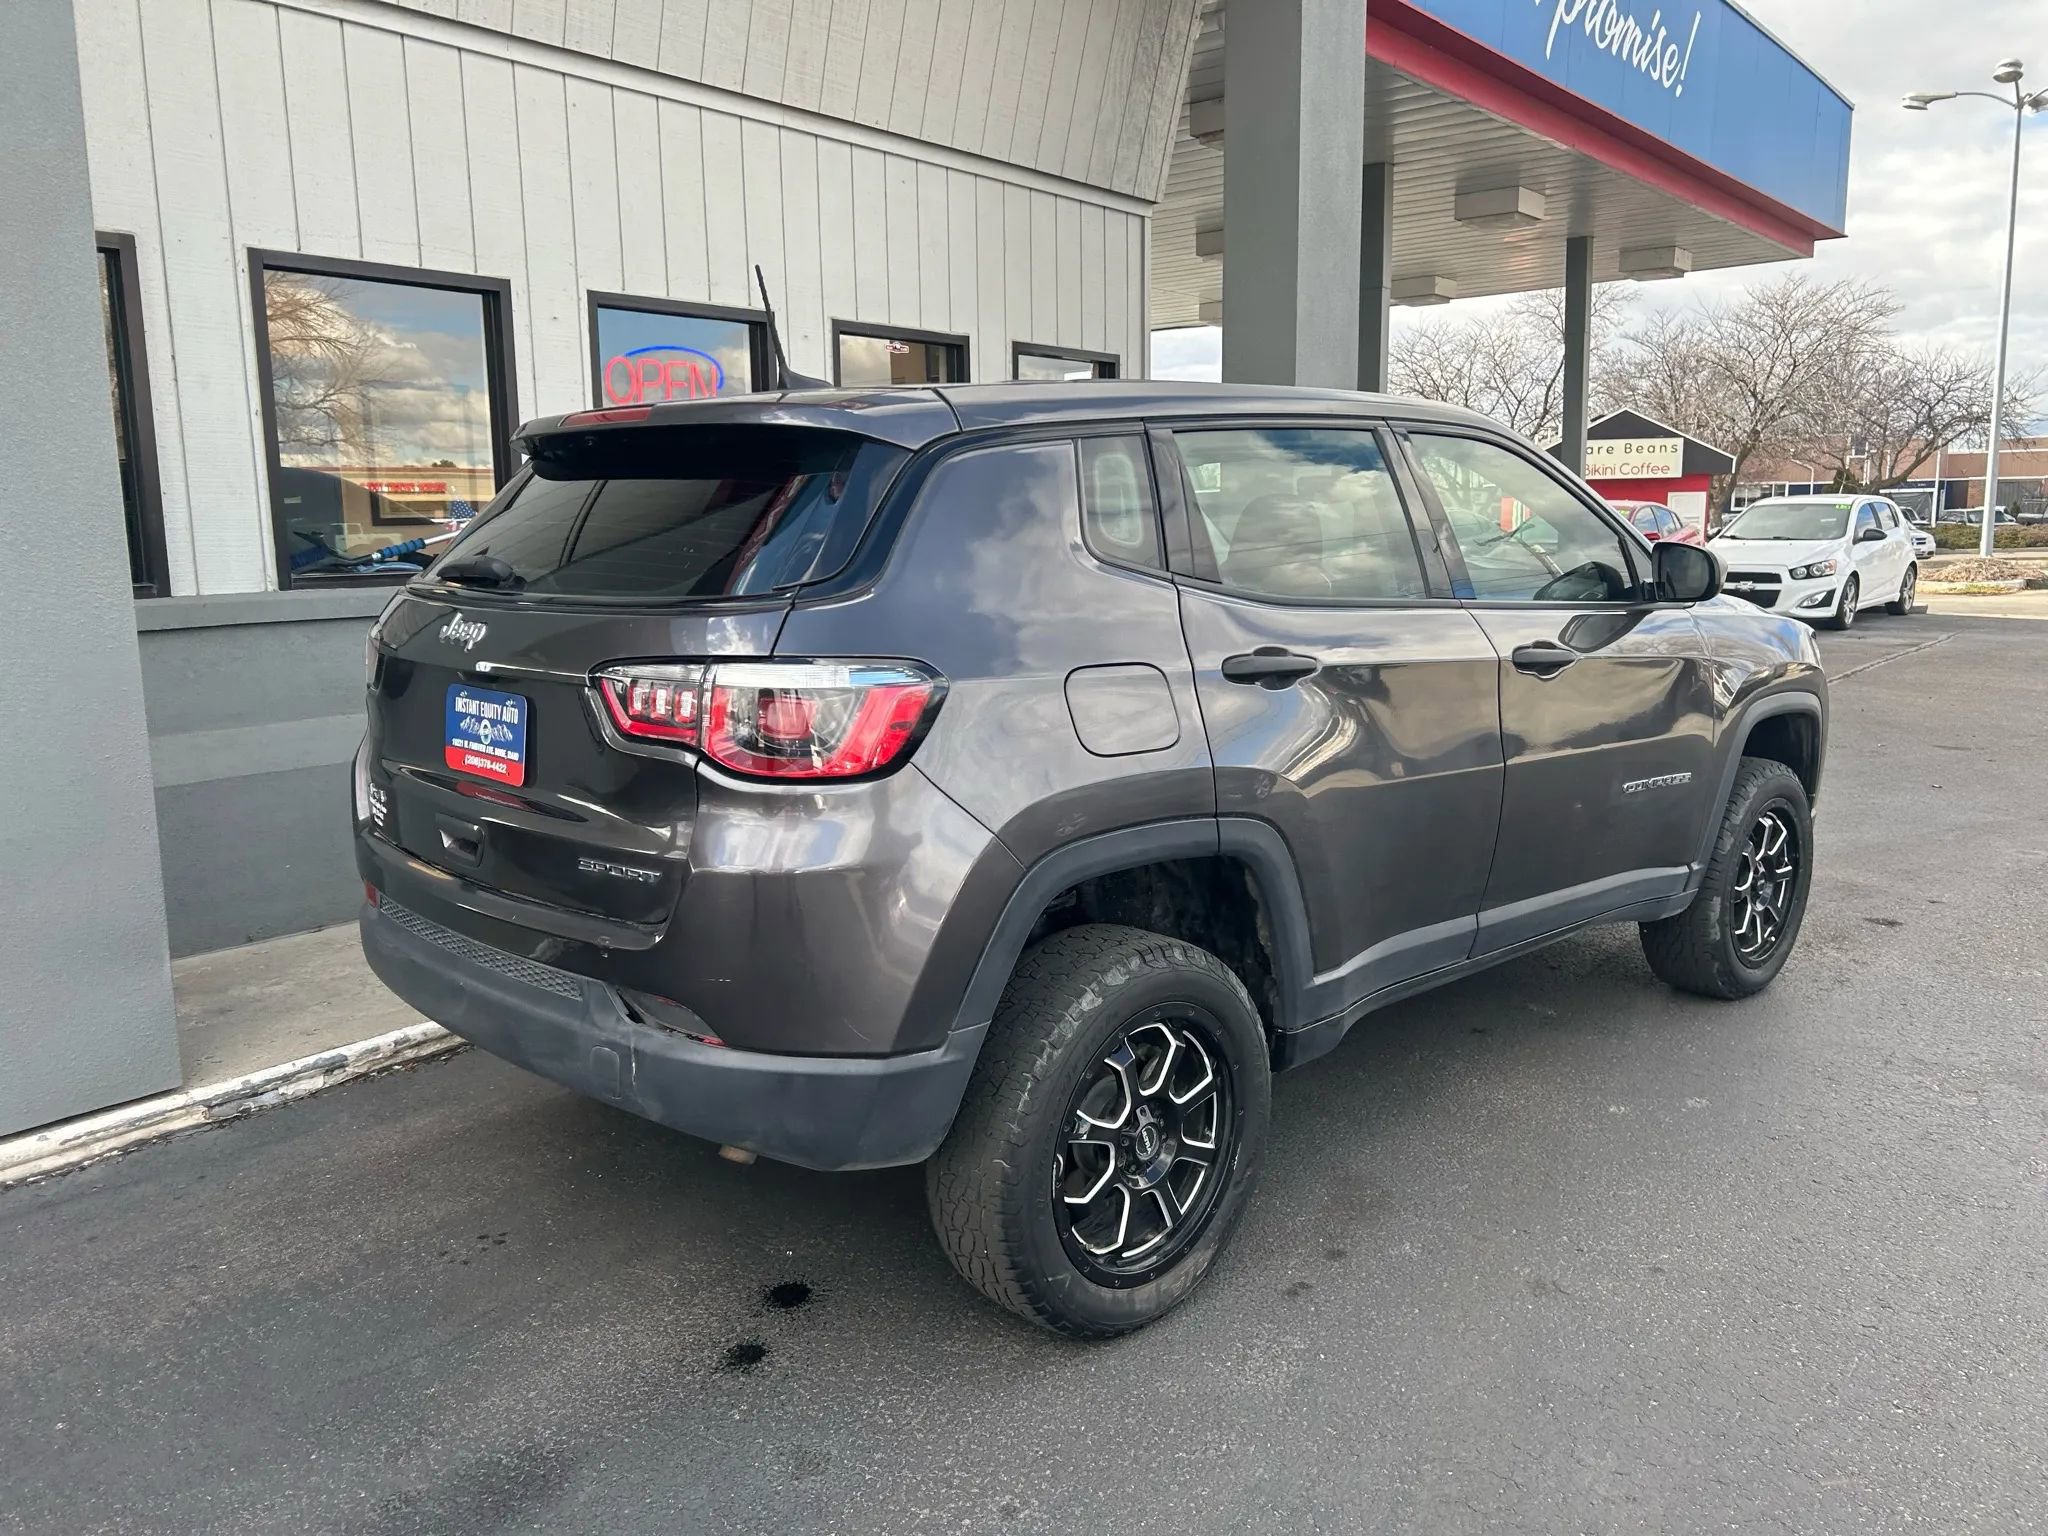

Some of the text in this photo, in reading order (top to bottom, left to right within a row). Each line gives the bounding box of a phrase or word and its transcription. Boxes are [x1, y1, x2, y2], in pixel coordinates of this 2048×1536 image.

[1546, 0, 1701, 98] promise!
[604, 355, 719, 405] OPEN
[1624, 442, 1679, 454] Beans
[1584, 462, 1671, 477] Bikini Coffee
[439, 612, 487, 653] Jeep
[455, 696, 519, 725] INSTANT EQUITY AUTO
[1622, 772, 1692, 793] COMPASS
[577, 857, 662, 883] SPORT
